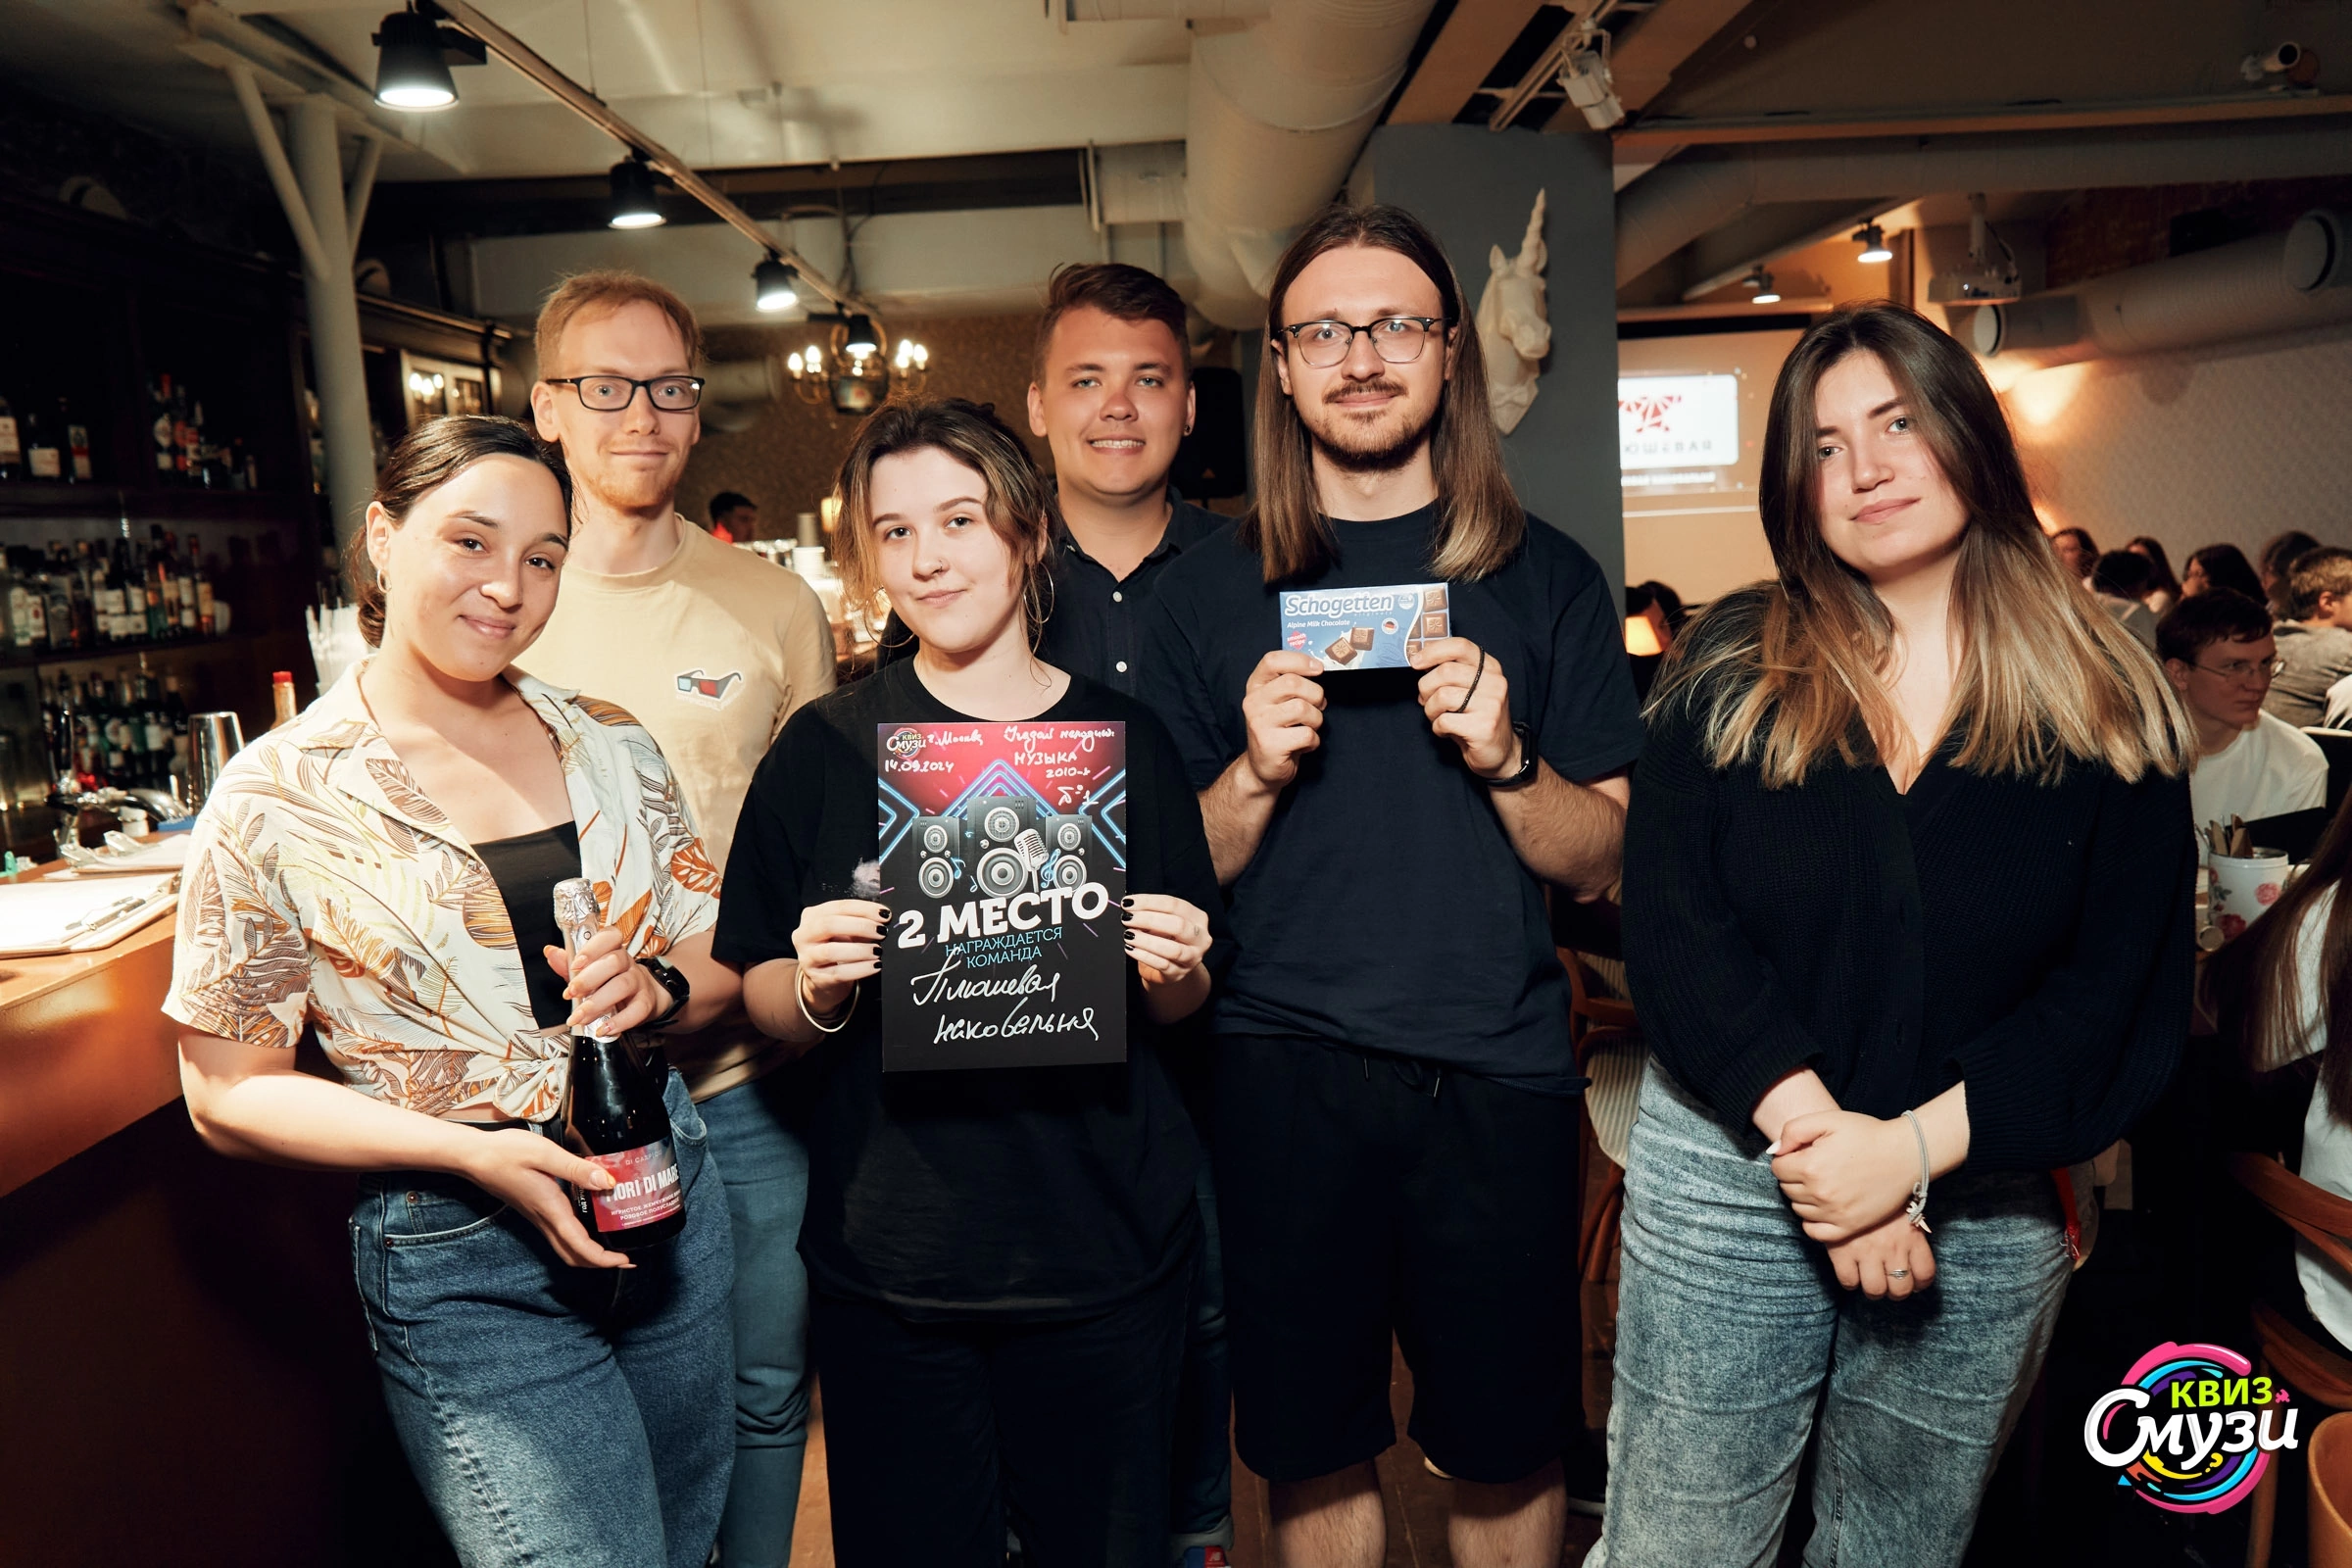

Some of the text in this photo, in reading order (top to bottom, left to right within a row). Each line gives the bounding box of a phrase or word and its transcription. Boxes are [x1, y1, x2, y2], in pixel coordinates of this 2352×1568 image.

[1624, 440, 1712, 454] ЮШЕВАЯ
[1286, 593, 1394, 617] Schogetten
[1287, 633, 1306, 642] smooth
[886, 736, 926, 752] Смузи
[898, 882, 1109, 949] 2 МЕСТО
[945, 926, 1063, 957] НАГРАЖДАЕТСЯ
[966, 946, 1043, 969] КОМАНДА
[910, 947, 1060, 1006] Плюшевая
[933, 997, 1099, 1045] наковальня
[643, 1174, 658, 1194] DI
